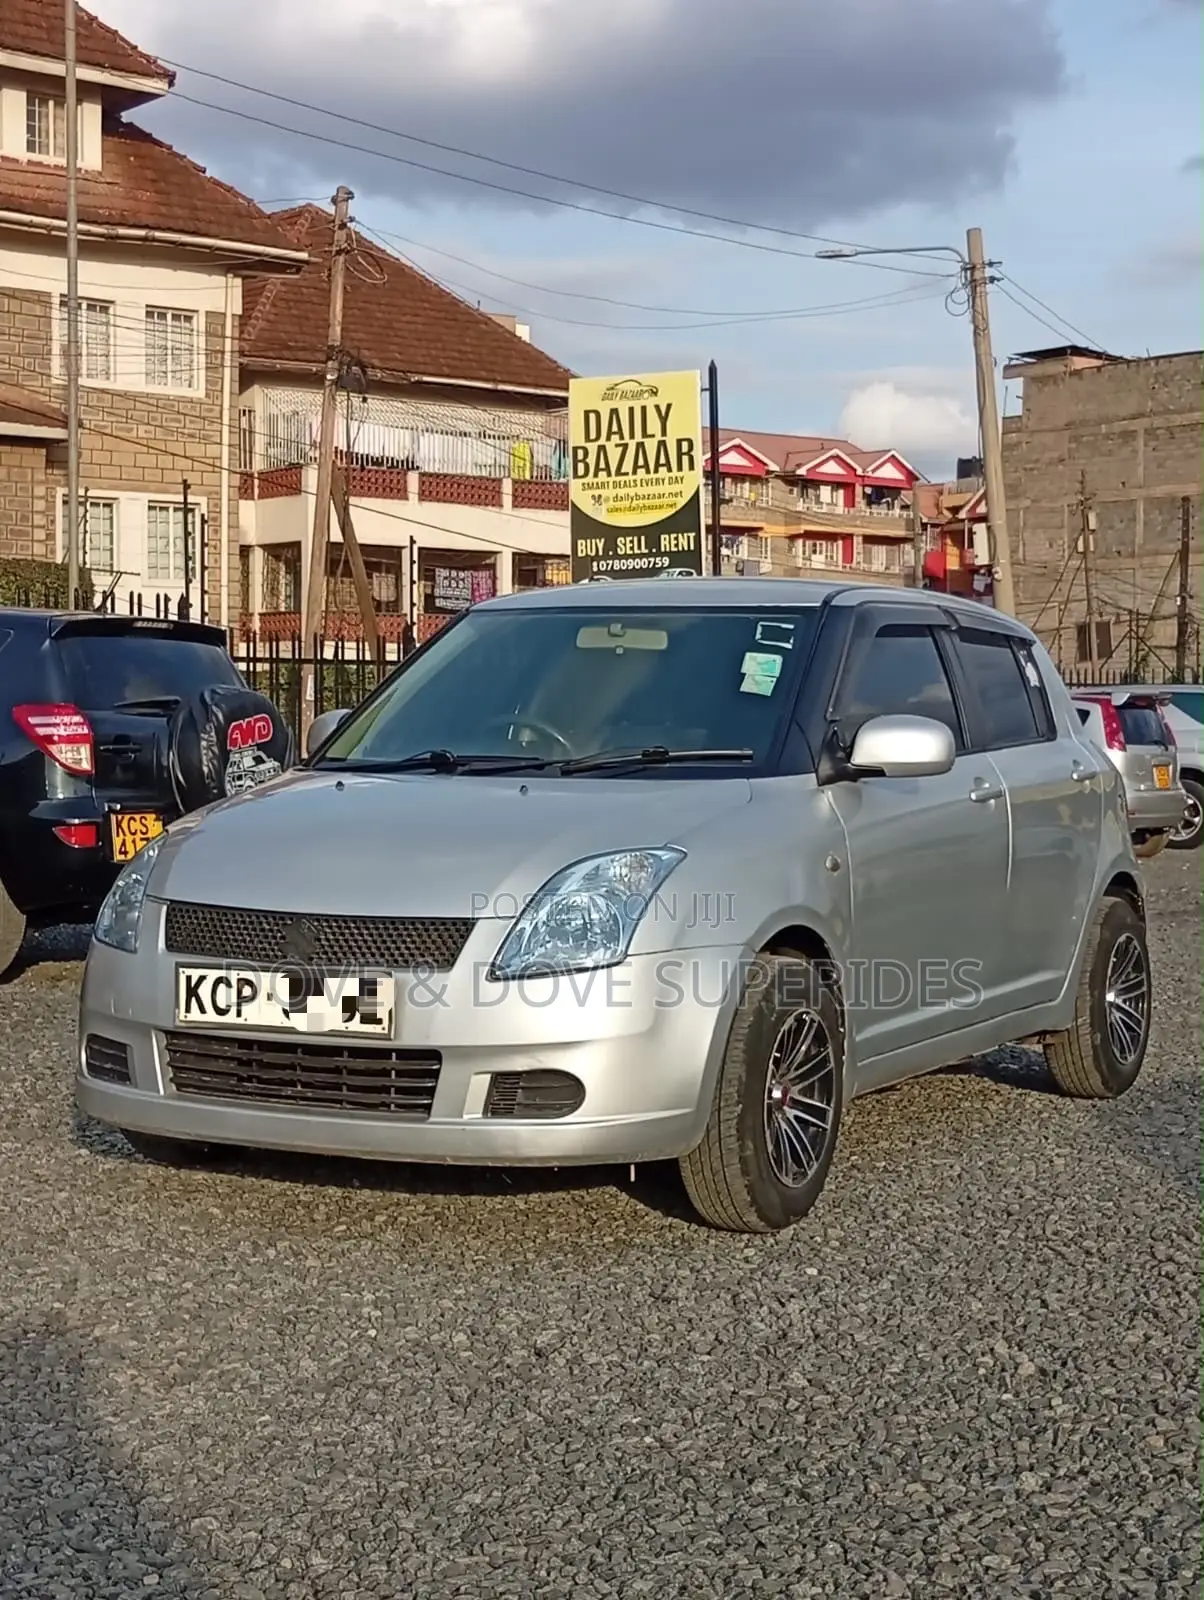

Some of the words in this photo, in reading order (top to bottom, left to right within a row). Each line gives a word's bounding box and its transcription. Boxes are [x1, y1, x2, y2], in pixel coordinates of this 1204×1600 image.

[583, 403, 673, 443] DAILY
[572, 438, 695, 479] BAZAAR
[581, 481, 610, 491] SMART
[612, 479, 638, 490] DEALS
[640, 477, 666, 488] EVERY
[668, 475, 685, 486] DAY
[612, 490, 683, 503] dailybazaar.net
[577, 538, 605, 557] BUY
[617, 535, 649, 555] SELL
[660, 532, 696, 552] RENT
[599, 556, 670, 571] 0780900759
[115, 815, 149, 837] KCS
[184, 974, 258, 1018] KCP
